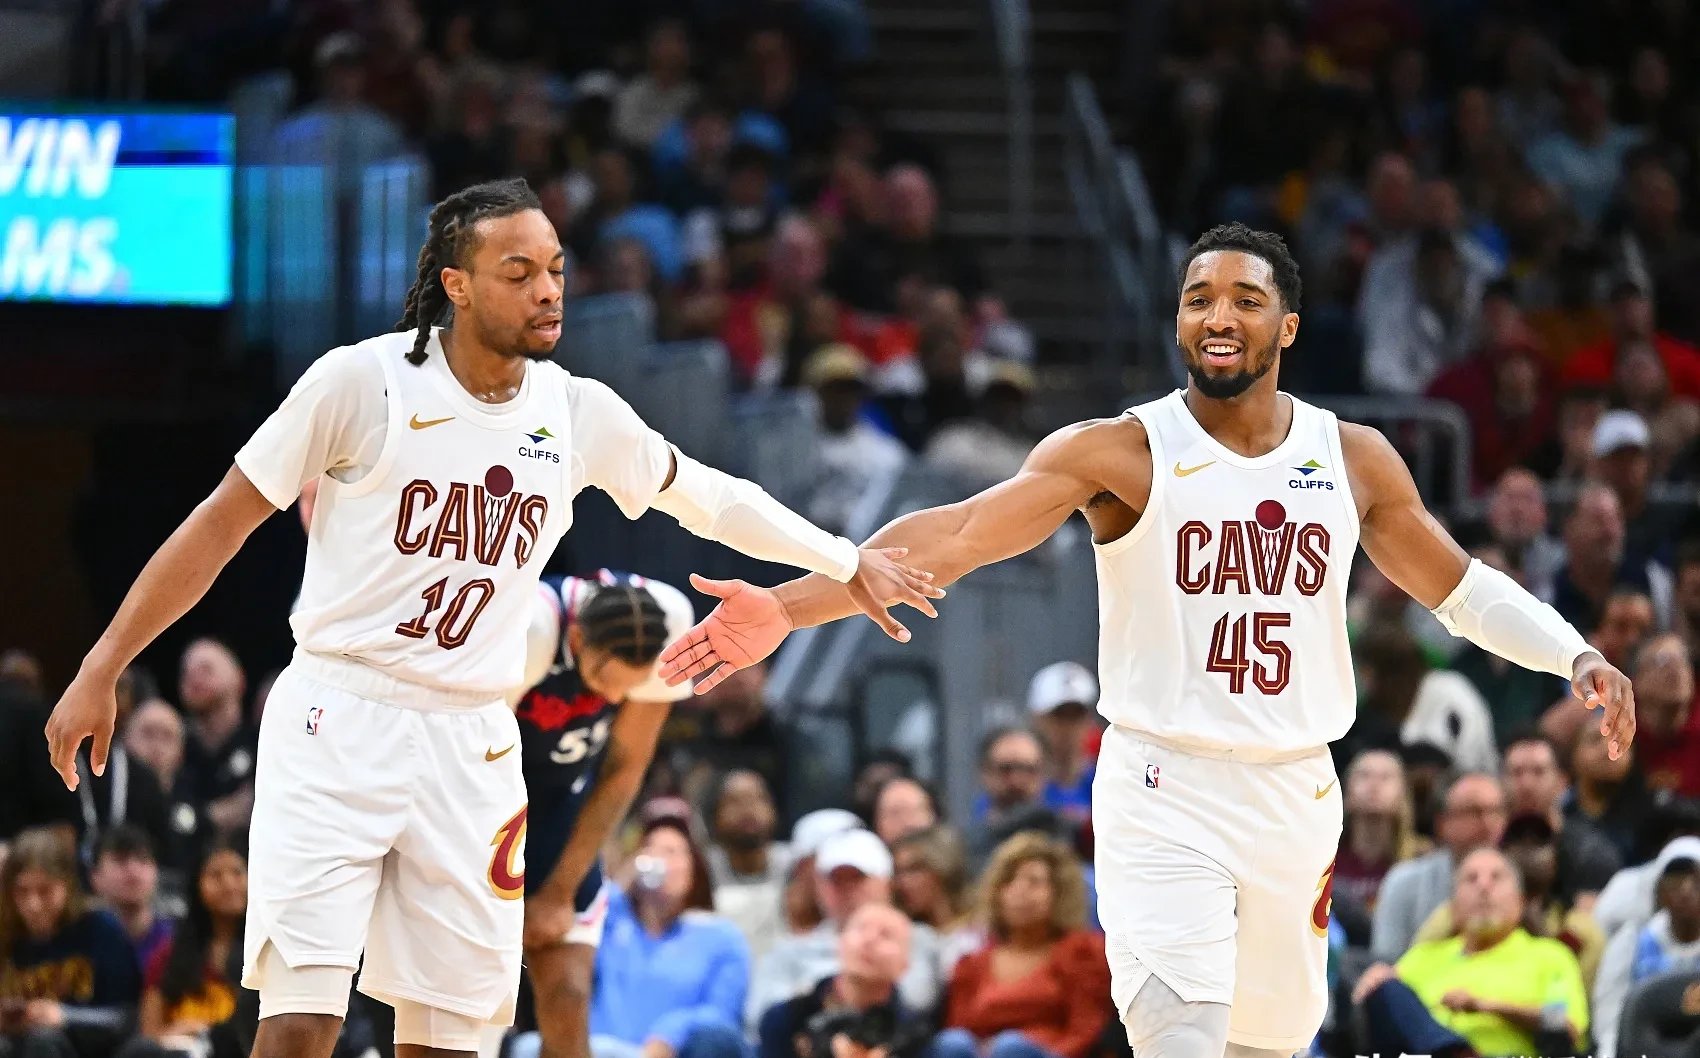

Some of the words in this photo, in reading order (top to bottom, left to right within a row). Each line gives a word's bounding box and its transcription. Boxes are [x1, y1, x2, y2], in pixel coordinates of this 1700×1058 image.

[518, 446, 560, 464] CLIFFS
[1288, 479, 1334, 491] CLIFFS
[393, 478, 549, 570] CAVS
[1175, 520, 1331, 597] CAVS
[394, 576, 496, 651] 10
[1205, 611, 1292, 696] 45
